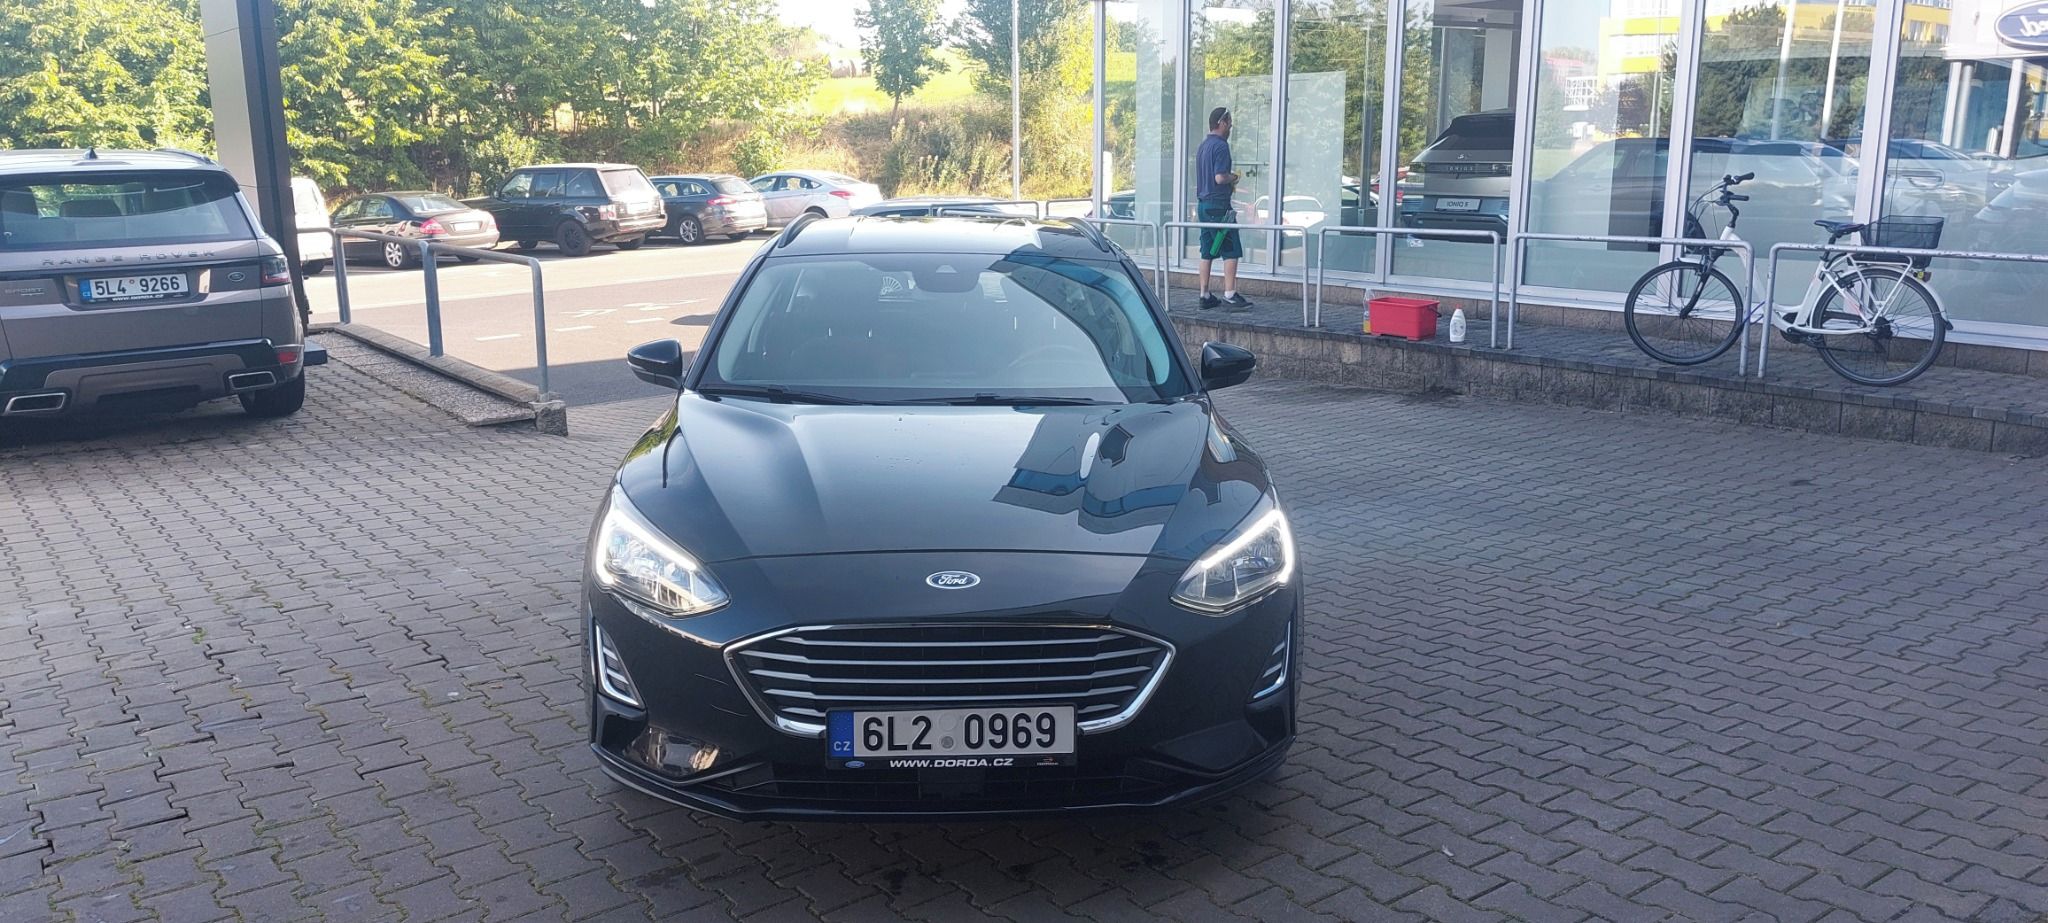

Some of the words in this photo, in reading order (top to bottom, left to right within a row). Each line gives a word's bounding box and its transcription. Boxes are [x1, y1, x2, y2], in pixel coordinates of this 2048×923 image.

[42, 254, 124, 266] RANGE
[139, 249, 215, 261] ROVER
[95, 280, 127, 296] 5L4
[139, 276, 181, 293] 9266
[938, 574, 968, 585] Ford
[862, 716, 932, 751] 6L2
[963, 712, 1056, 749] 0969
[833, 741, 851, 751] CZ
[889, 757, 1014, 768] WWW.DORDA.CZ
